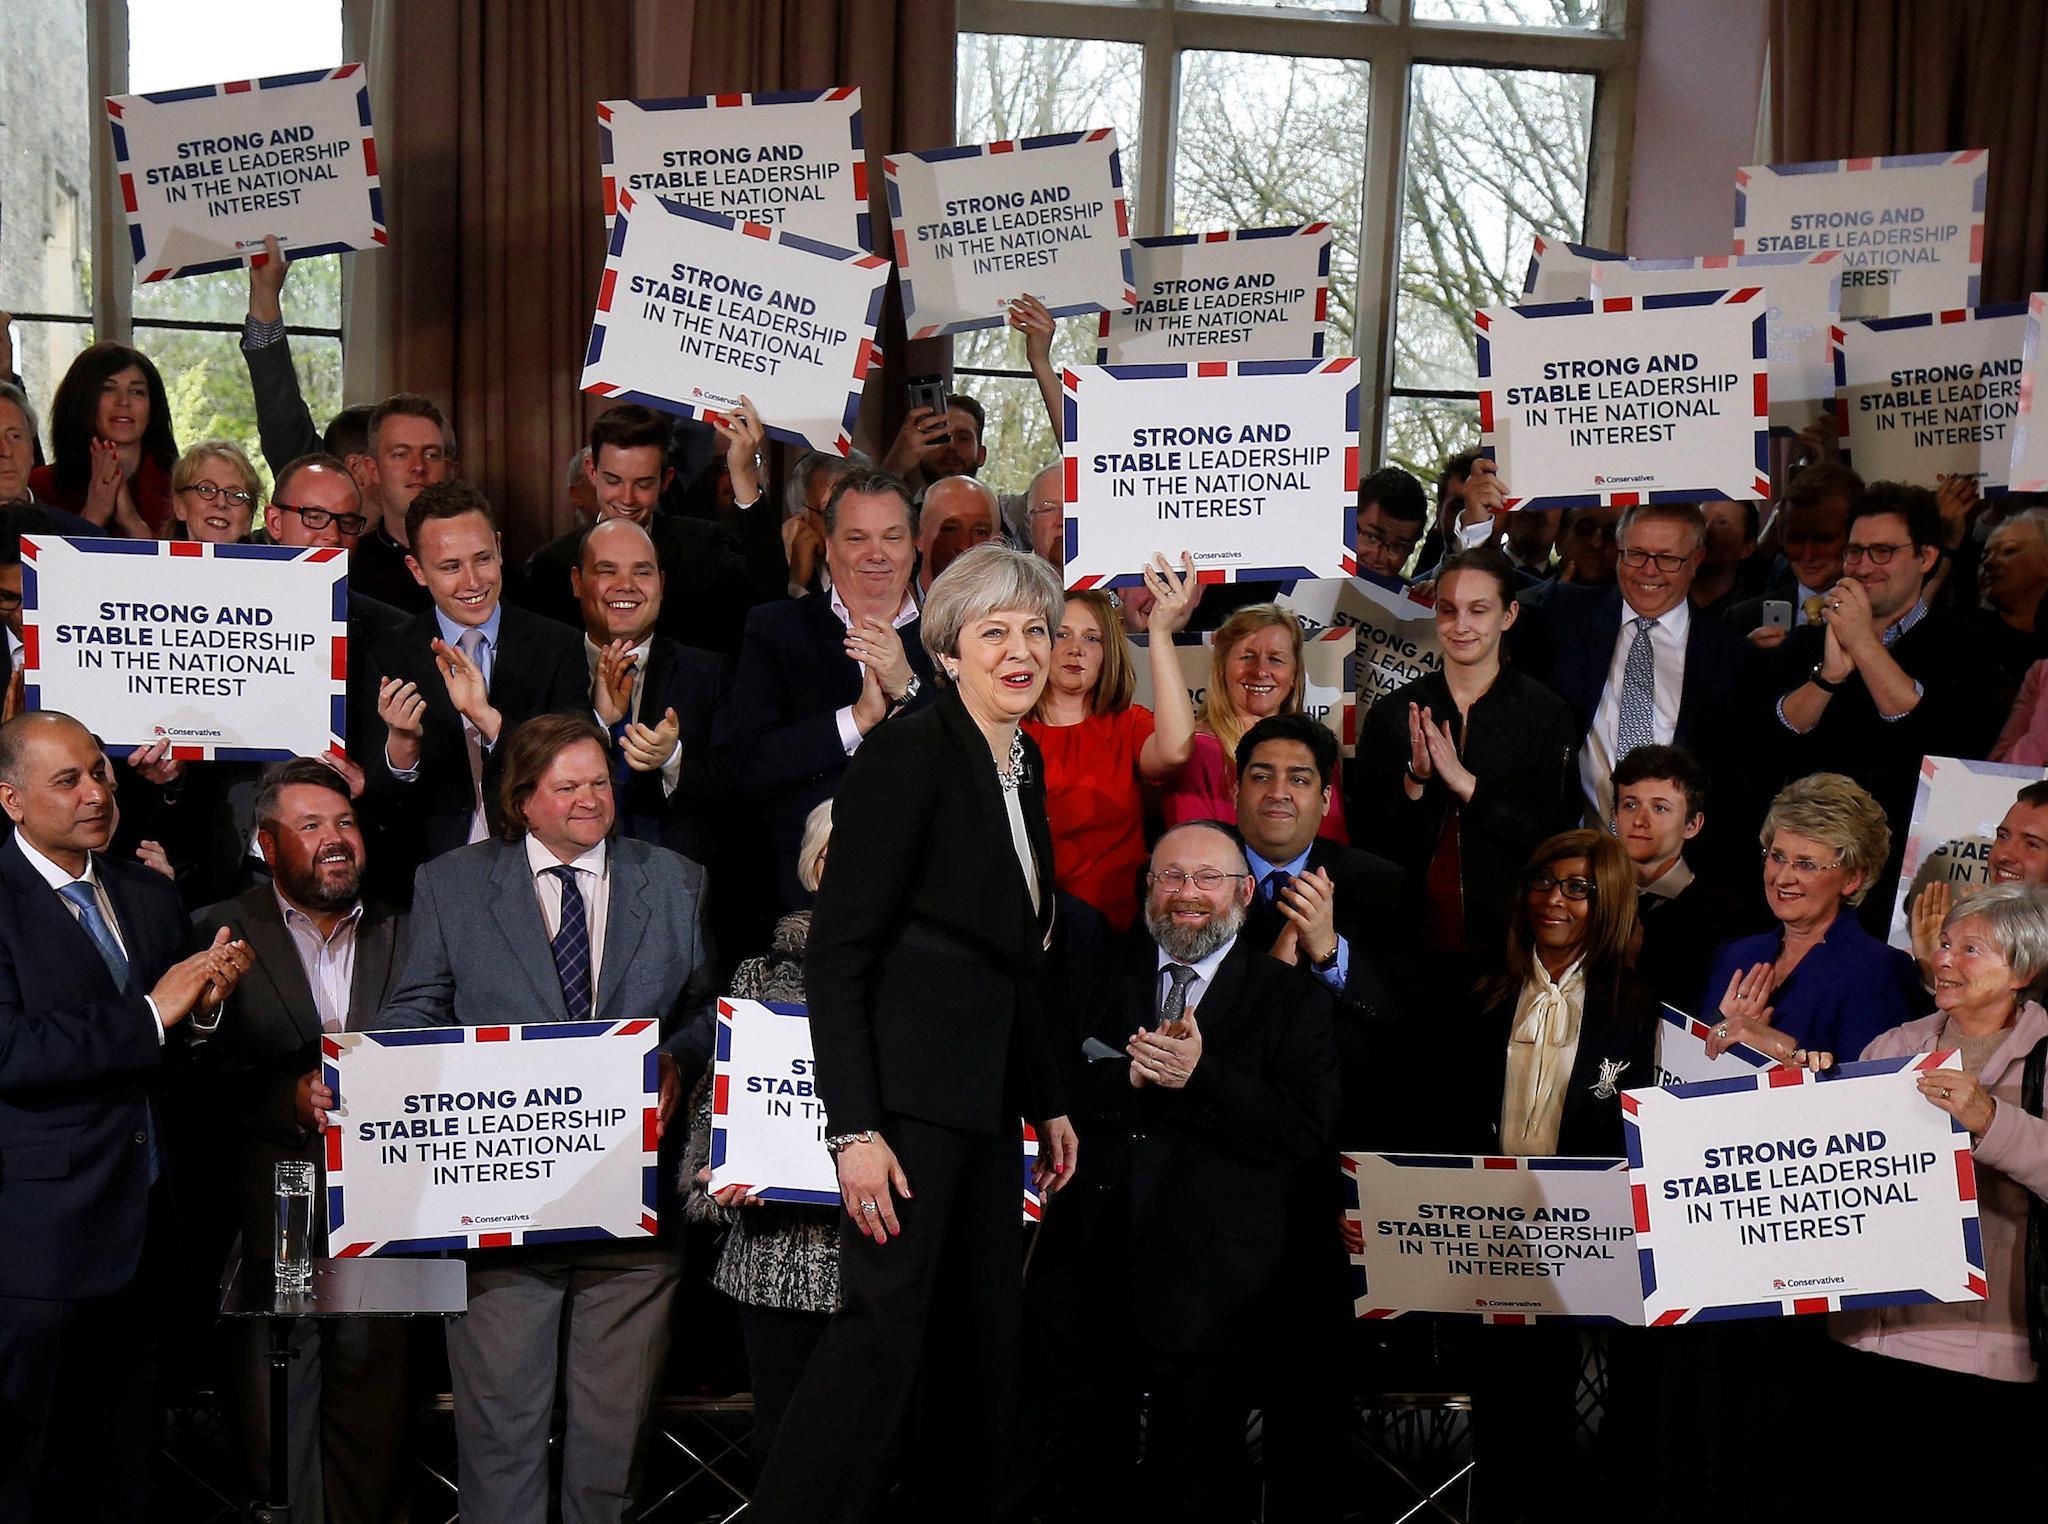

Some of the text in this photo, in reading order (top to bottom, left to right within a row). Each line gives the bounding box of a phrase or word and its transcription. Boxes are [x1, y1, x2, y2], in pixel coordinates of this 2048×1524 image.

[177, 125, 314, 159] STRONG AND
[146, 141, 350, 185] STABLE LEADERSHIP
[663, 145, 803, 168] STRONG AND
[166, 163, 338, 203] IN THE NATIONAL
[629, 163, 840, 190] STABLE LEADERSHIP
[208, 188, 301, 217] INTEREST
[674, 191, 715, 207] THE
[721, 185, 825, 206] NATIONAL
[946, 186, 1070, 217] STRONG AND
[723, 207, 786, 224] REST
[917, 202, 1103, 241] STABLE LEADERSHIP
[1790, 207, 1925, 231] STRONG AND
[935, 224, 1092, 259] IN THE NATIONAL
[1757, 225, 1958, 252] STABLE LEADERSHIP
[973, 248, 1058, 275] INTEREST
[1843, 247, 1940, 267] NATIONAL
[671, 263, 816, 316] STRONG AND
[1153, 273, 1275, 295] STRONG AND
[1841, 269, 1901, 288] EREST
[630, 276, 847, 346] STABLE LEADERSHIP
[1194, 288, 1305, 310] LEADERSHIP
[1135, 308, 1289, 332] IN THE NATIONAL
[643, 302, 823, 366] IN THE NATIONAL
[1168, 328, 1253, 347] INTEREST
[680, 335, 781, 376] INTEREST
[1544, 353, 1698, 380] STRONG AND
[1891, 358, 2023, 388] STRONG AND
[1507, 374, 1738, 405] STABLE LEADERSHIP
[1860, 379, 2021, 411] STABLE LEADERS
[1526, 398, 1720, 427] IN THE NATIONAL
[1876, 401, 2019, 430] IN THE NATION
[1133, 424, 1291, 447] STRONG AND
[1570, 423, 1676, 446] INTEREST
[1915, 423, 2007, 448] INTEREST
[1093, 447, 1330, 473] STABLE LEADERSHIP
[1113, 471, 1311, 497] IN THE NATIONAL
[1606, 475, 1655, 483] Conservatives
[1158, 497, 1266, 519] INTEREST
[1193, 551, 1242, 560] Conservatives
[100, 602, 273, 626] STRONG AND
[56, 625, 315, 651] STABLE LEADERSHIP
[1333, 611, 1418, 657] STRONG
[78, 649, 295, 675] IN THE NATIONAL
[128, 675, 247, 696] INTEREST
[168, 728, 221, 736] Conservatives
[1949, 863, 1972, 881] IN
[746, 1076, 817, 1097] STAB
[404, 1086, 582, 1114] STRONG AND
[767, 1099, 827, 1120] IN TH
[359, 1108, 626, 1141] STABLE LEADERSHIP
[382, 1133, 605, 1164] IN THE NATIONAL
[1704, 1130, 1886, 1169] STRONG AND
[434, 1160, 556, 1185] INTEREST
[1663, 1152, 1936, 1200] STABLE LEADERSHIP
[1418, 1204, 1590, 1223] STRONG AND
[1687, 1182, 1918, 1224] IN THE NATIONAL
[475, 1213, 530, 1224] Conservatives
[1377, 1220, 1634, 1241] STABLE LEADERSHIP
[1740, 1213, 1866, 1245] INTEREST
[1399, 1239, 1615, 1259] IN THE NATIONAL
[1448, 1259, 1566, 1277] INTEREST
[1787, 1276, 1845, 1287] Conservatives
